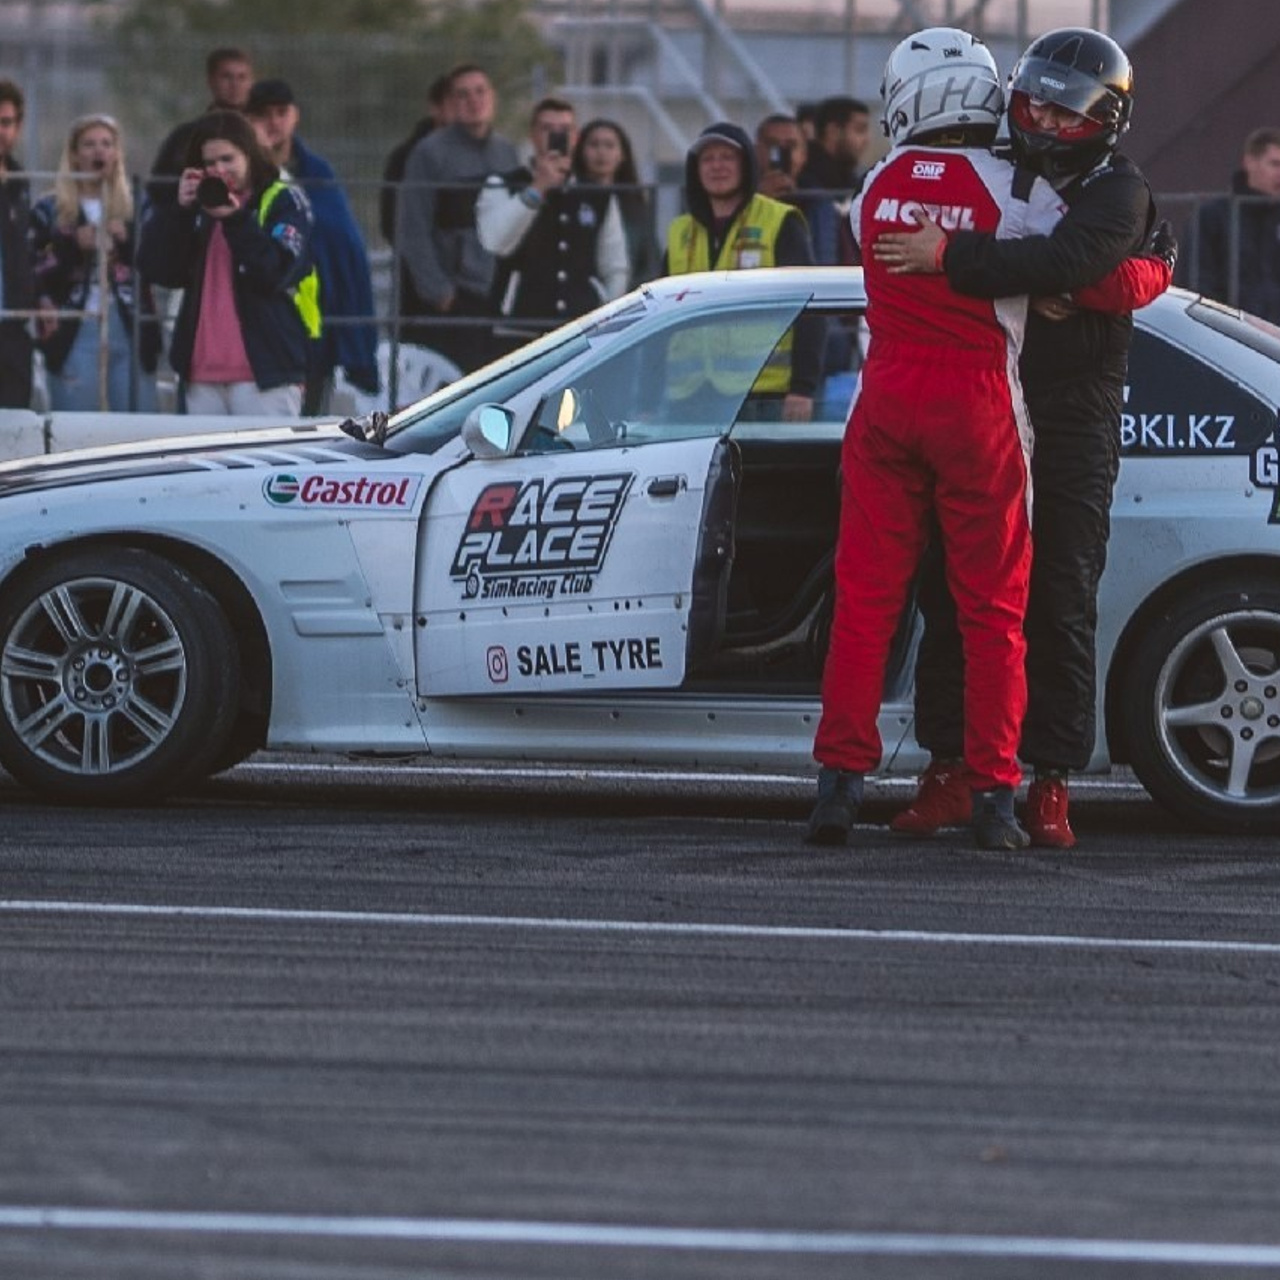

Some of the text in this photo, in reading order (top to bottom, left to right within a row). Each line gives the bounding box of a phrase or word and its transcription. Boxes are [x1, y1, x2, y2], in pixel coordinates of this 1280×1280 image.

[912, 162, 945, 178] OMP
[873, 198, 975, 230] MOTUL
[300, 475, 410, 505] Castrol
[471, 478, 624, 528] RACE
[457, 525, 605, 568] PLACE
[480, 572, 593, 599] SimRacing Club
[516, 636, 663, 679] SALE_TYRE
